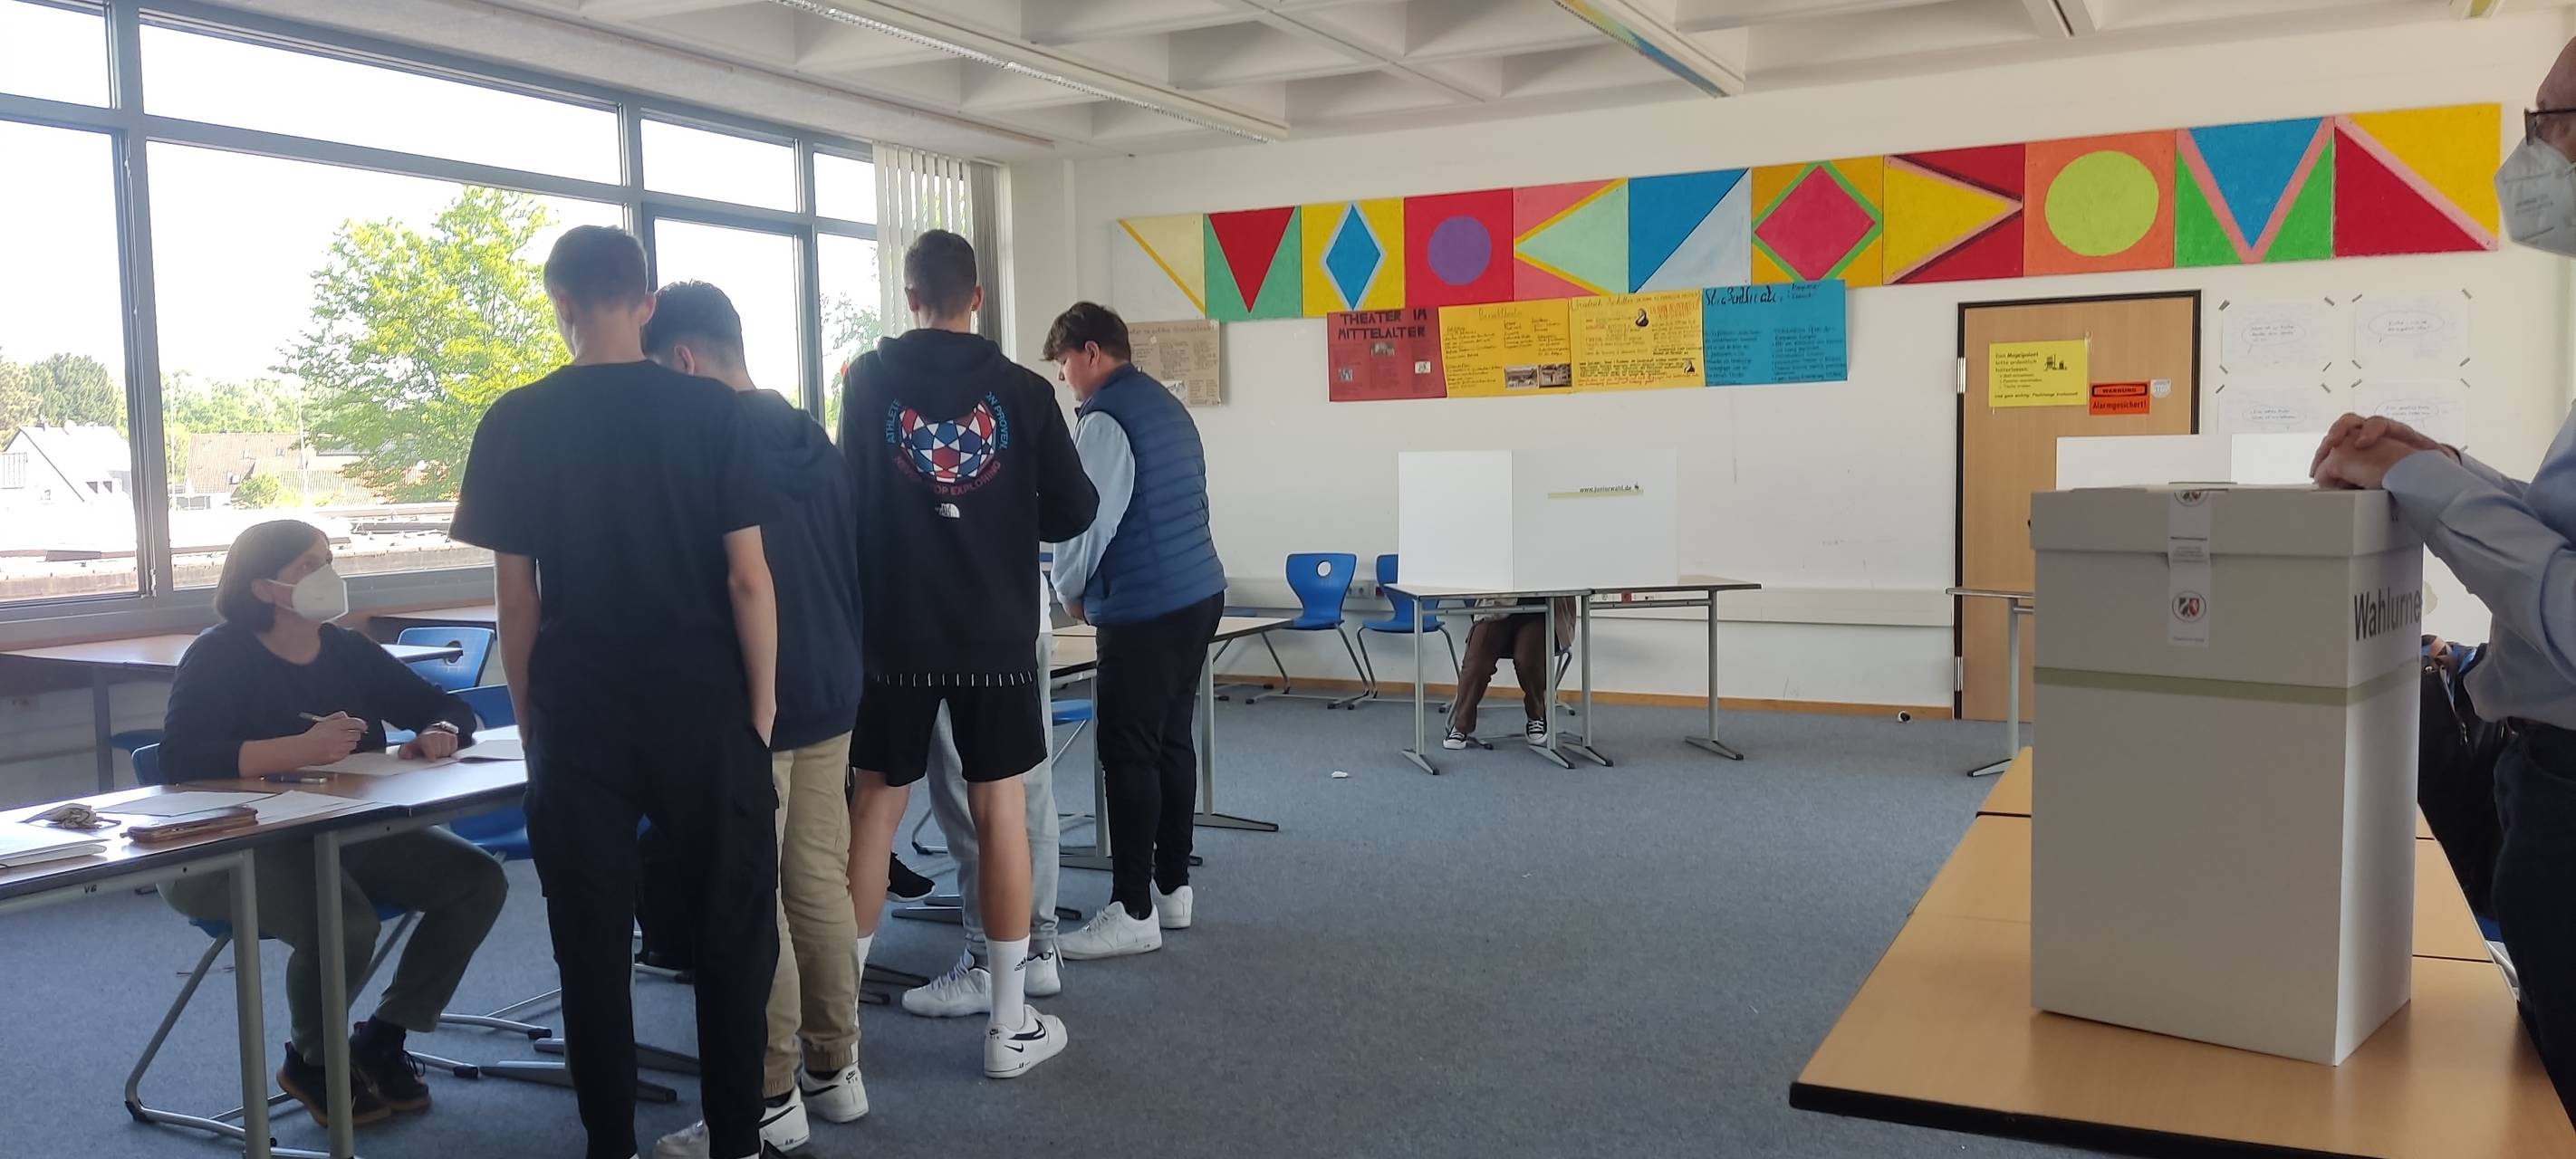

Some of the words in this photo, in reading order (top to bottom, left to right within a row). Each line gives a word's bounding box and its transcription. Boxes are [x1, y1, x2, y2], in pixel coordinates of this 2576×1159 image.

[1341, 310, 1401, 325] THEATER
[1413, 308, 1428, 321] IM
[1338, 327, 1426, 340] MITTELALTER
[2092, 399, 2147, 410] Alarmgesichert!
[2354, 586, 2422, 642] Wahlurne
